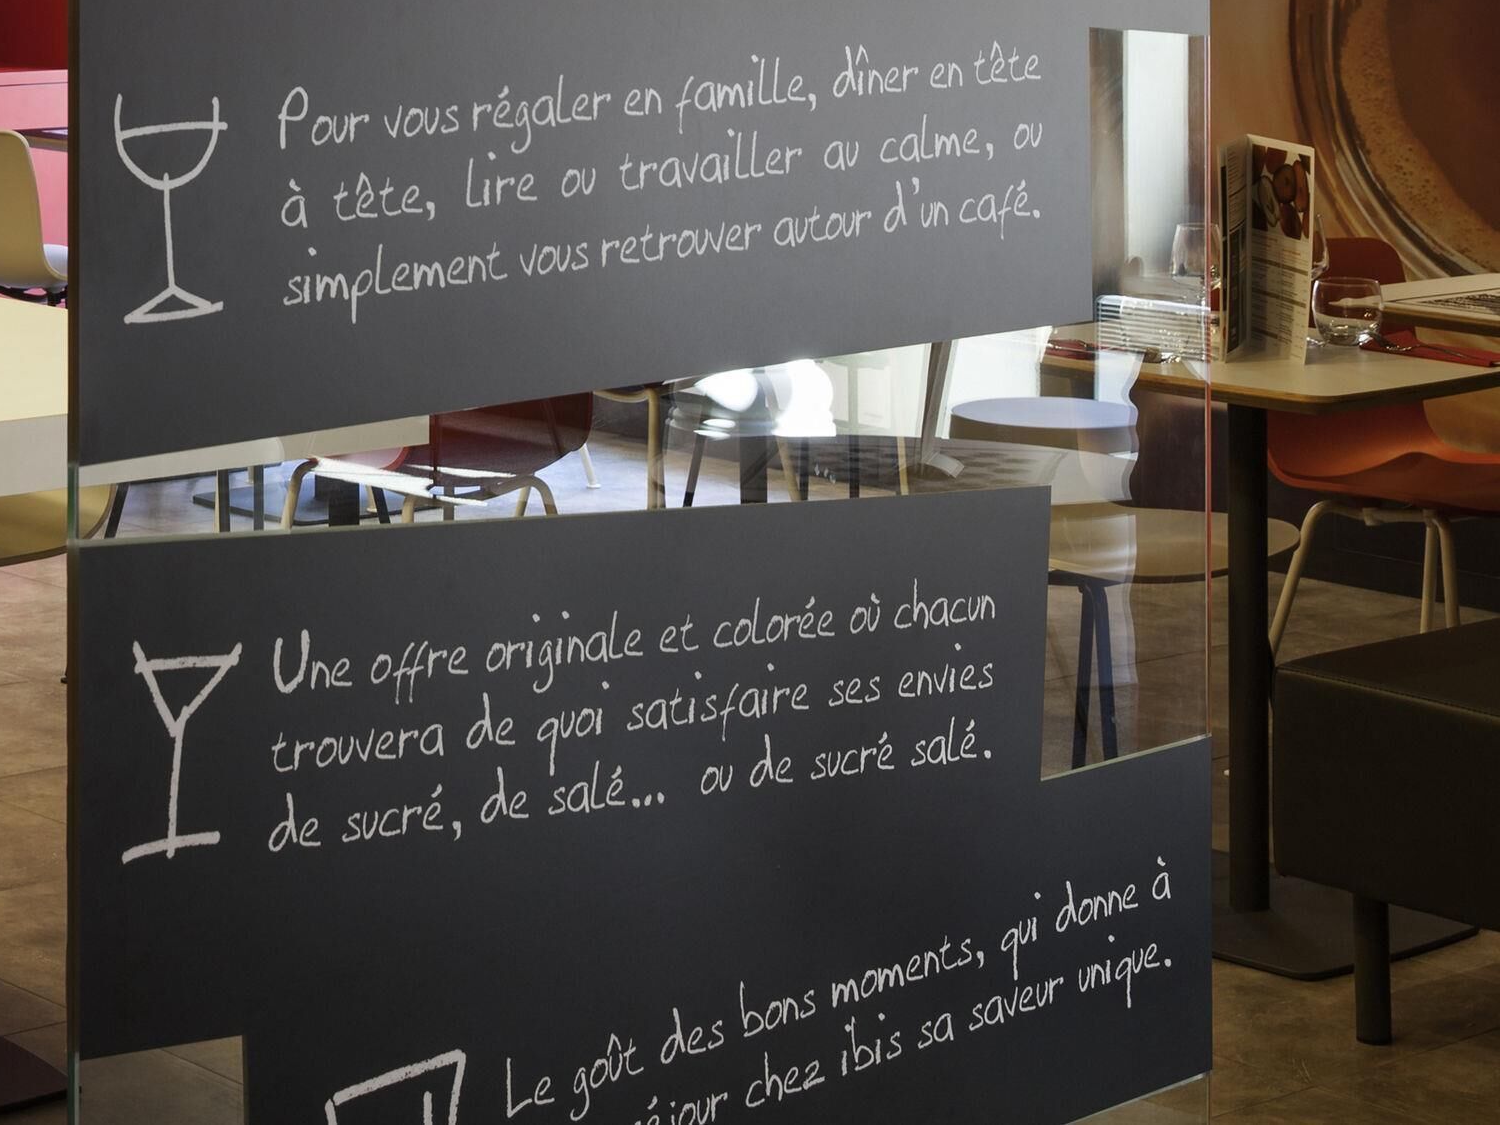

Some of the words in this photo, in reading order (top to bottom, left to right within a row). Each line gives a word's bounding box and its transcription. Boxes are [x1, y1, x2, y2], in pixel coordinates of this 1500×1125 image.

[277, 85, 370, 151] Pour
[383, 104, 460, 139] vous
[472, 74, 612, 155] régaler
[623, 87, 663, 117] en
[675, 54, 817, 138] famille,
[832, 44, 919, 99] dîner
[929, 62, 964, 89] en
[973, 40, 1042, 85] tête
[280, 178, 309, 229] à
[332, 171, 436, 222] tête,
[465, 150, 538, 208] lire
[560, 167, 597, 198] ou
[618, 127, 803, 191] travailler
[823, 140, 860, 171] au
[879, 113, 994, 162] calme,
[1013, 122, 1043, 150] ou
[282, 241, 509, 325] simplement
[519, 241, 589, 277] vous
[600, 221, 763, 268] retrouver
[773, 205, 873, 248] autour
[883, 176, 949, 233] d'un
[958, 178, 1041, 240] café.
[270, 723, 445, 773] trouvera
[465, 691, 516, 750] de
[536, 680, 610, 777] quoi
[626, 662, 810, 743] satisfaire
[827, 675, 881, 708] ses
[897, 642, 994, 698] envies
[272, 628, 353, 695] Une
[370, 640, 469, 706] offre
[485, 610, 644, 695] originale
[658, 613, 703, 653] et
[712, 595, 836, 645] colorée
[849, 592, 881, 635] où
[893, 577, 996, 630] chacun
[267, 791, 322, 853] de
[341, 783, 462, 844] sucré,
[479, 765, 530, 825] de
[547, 759, 666, 816] salé...
[700, 764, 734, 796] ou
[749, 733, 794, 788] de
[810, 730, 895, 781] sucré
[910, 715, 992, 768] salé.
[505, 1056, 556, 1119] Le
[569, 1032, 645, 1122] goût
[659, 1006, 725, 1065] des
[739, 980, 817, 1039] bons
[831, 934, 985, 1009] moments,
[1000, 891, 1042, 982] qui
[1055, 879, 1139, 933] donne
[1151, 855, 1172, 901] à
[744, 1050, 826, 1108] chez
[840, 1012, 903, 1077] ibis
[916, 1012, 955, 1050] sa
[968, 976, 1065, 1032] saveur
[1078, 934, 1173, 1009] unique.
